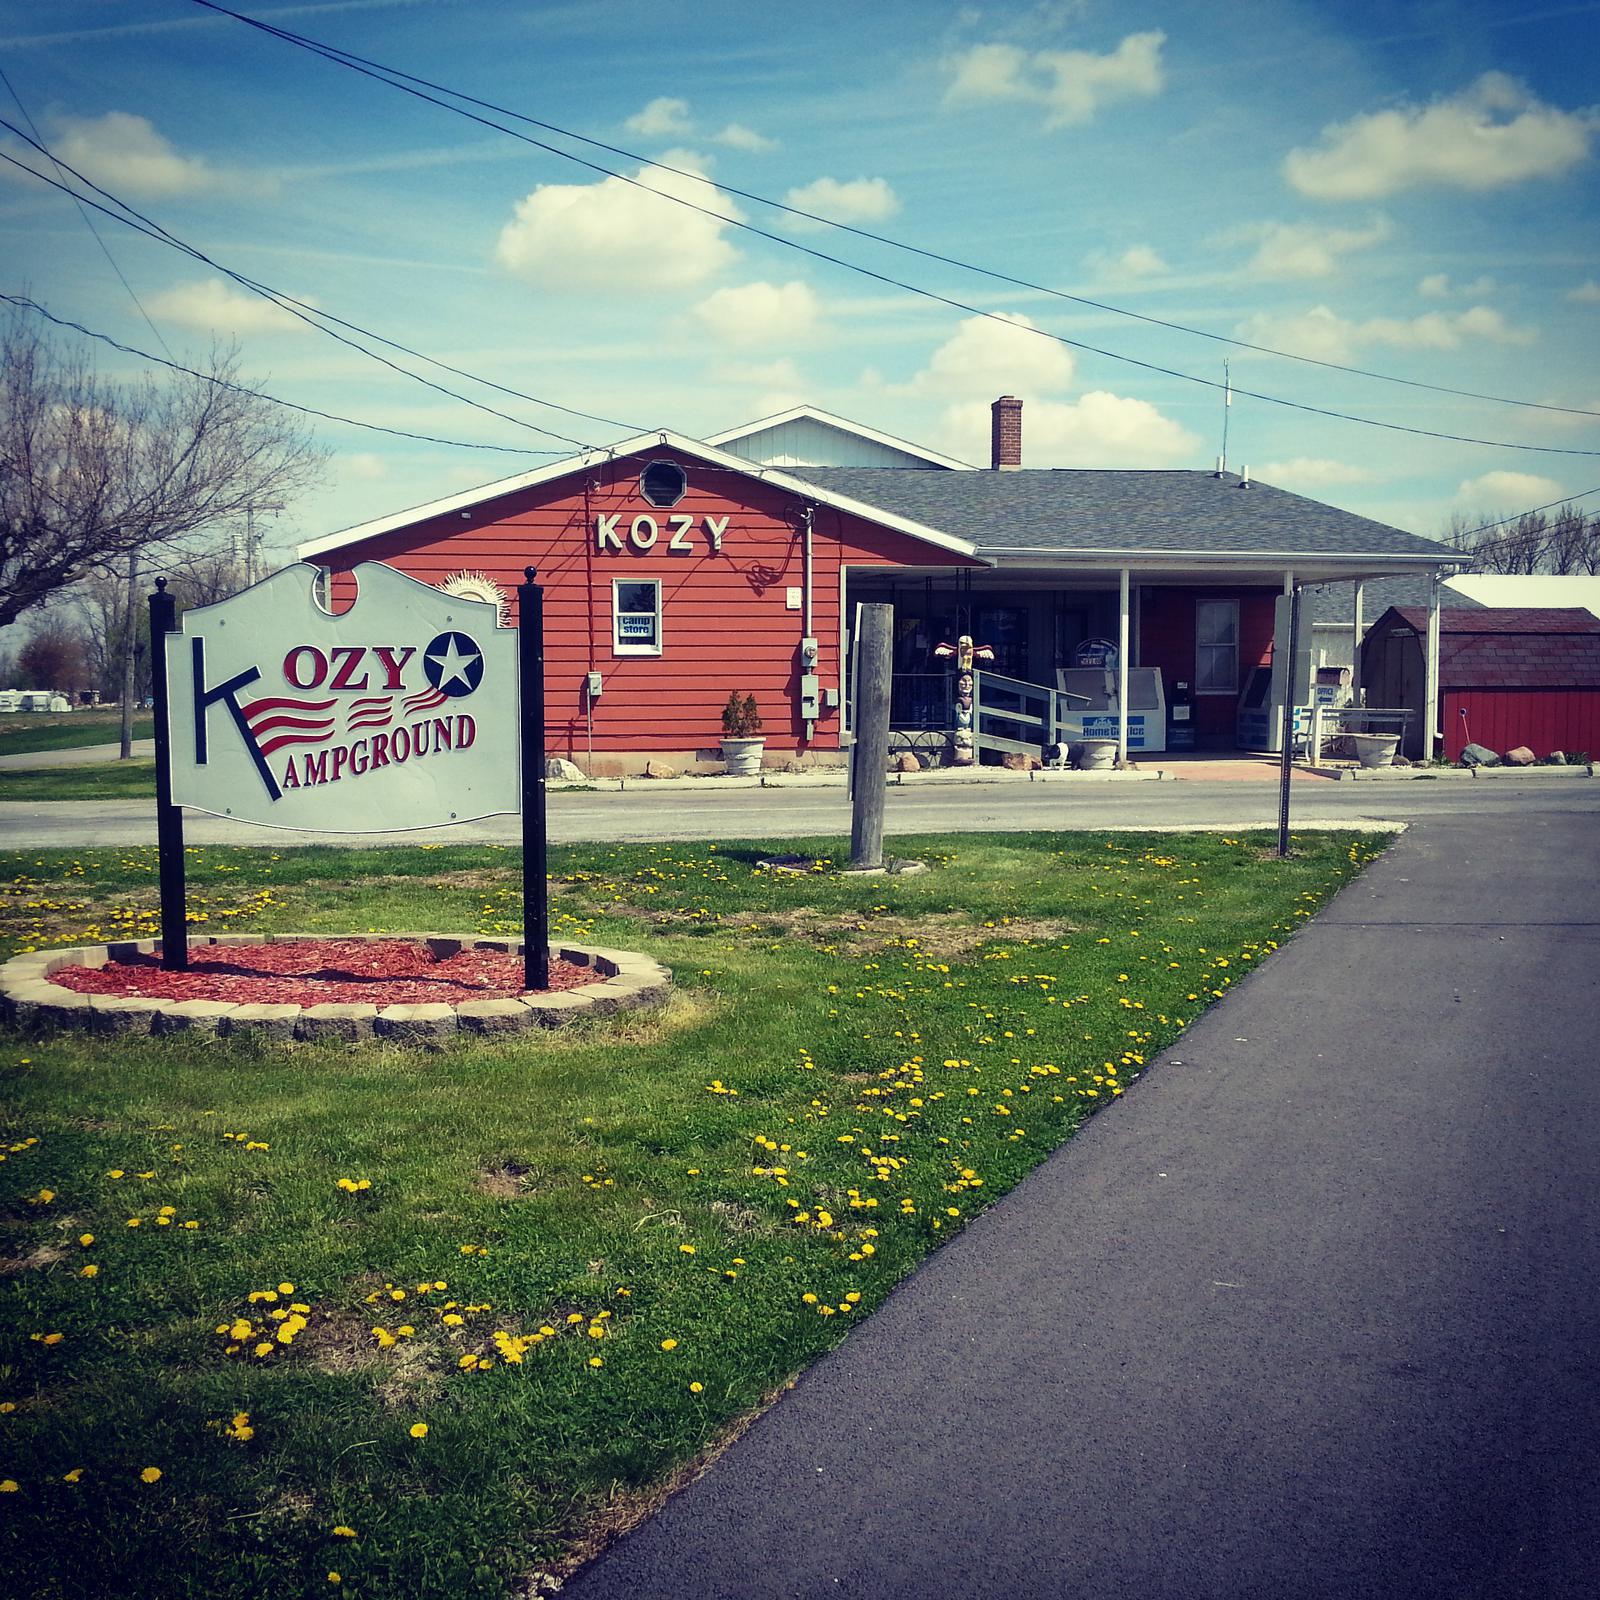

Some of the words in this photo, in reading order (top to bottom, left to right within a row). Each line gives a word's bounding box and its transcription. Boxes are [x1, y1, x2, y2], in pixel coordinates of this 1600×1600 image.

[597, 513, 730, 550] KOZY
[623, 616, 650, 625] camp
[624, 625, 649, 633] store
[1317, 687, 1334, 696] OFFICE
[1083, 727, 1110, 738] Home
[1130, 726, 1145, 737] Ice
